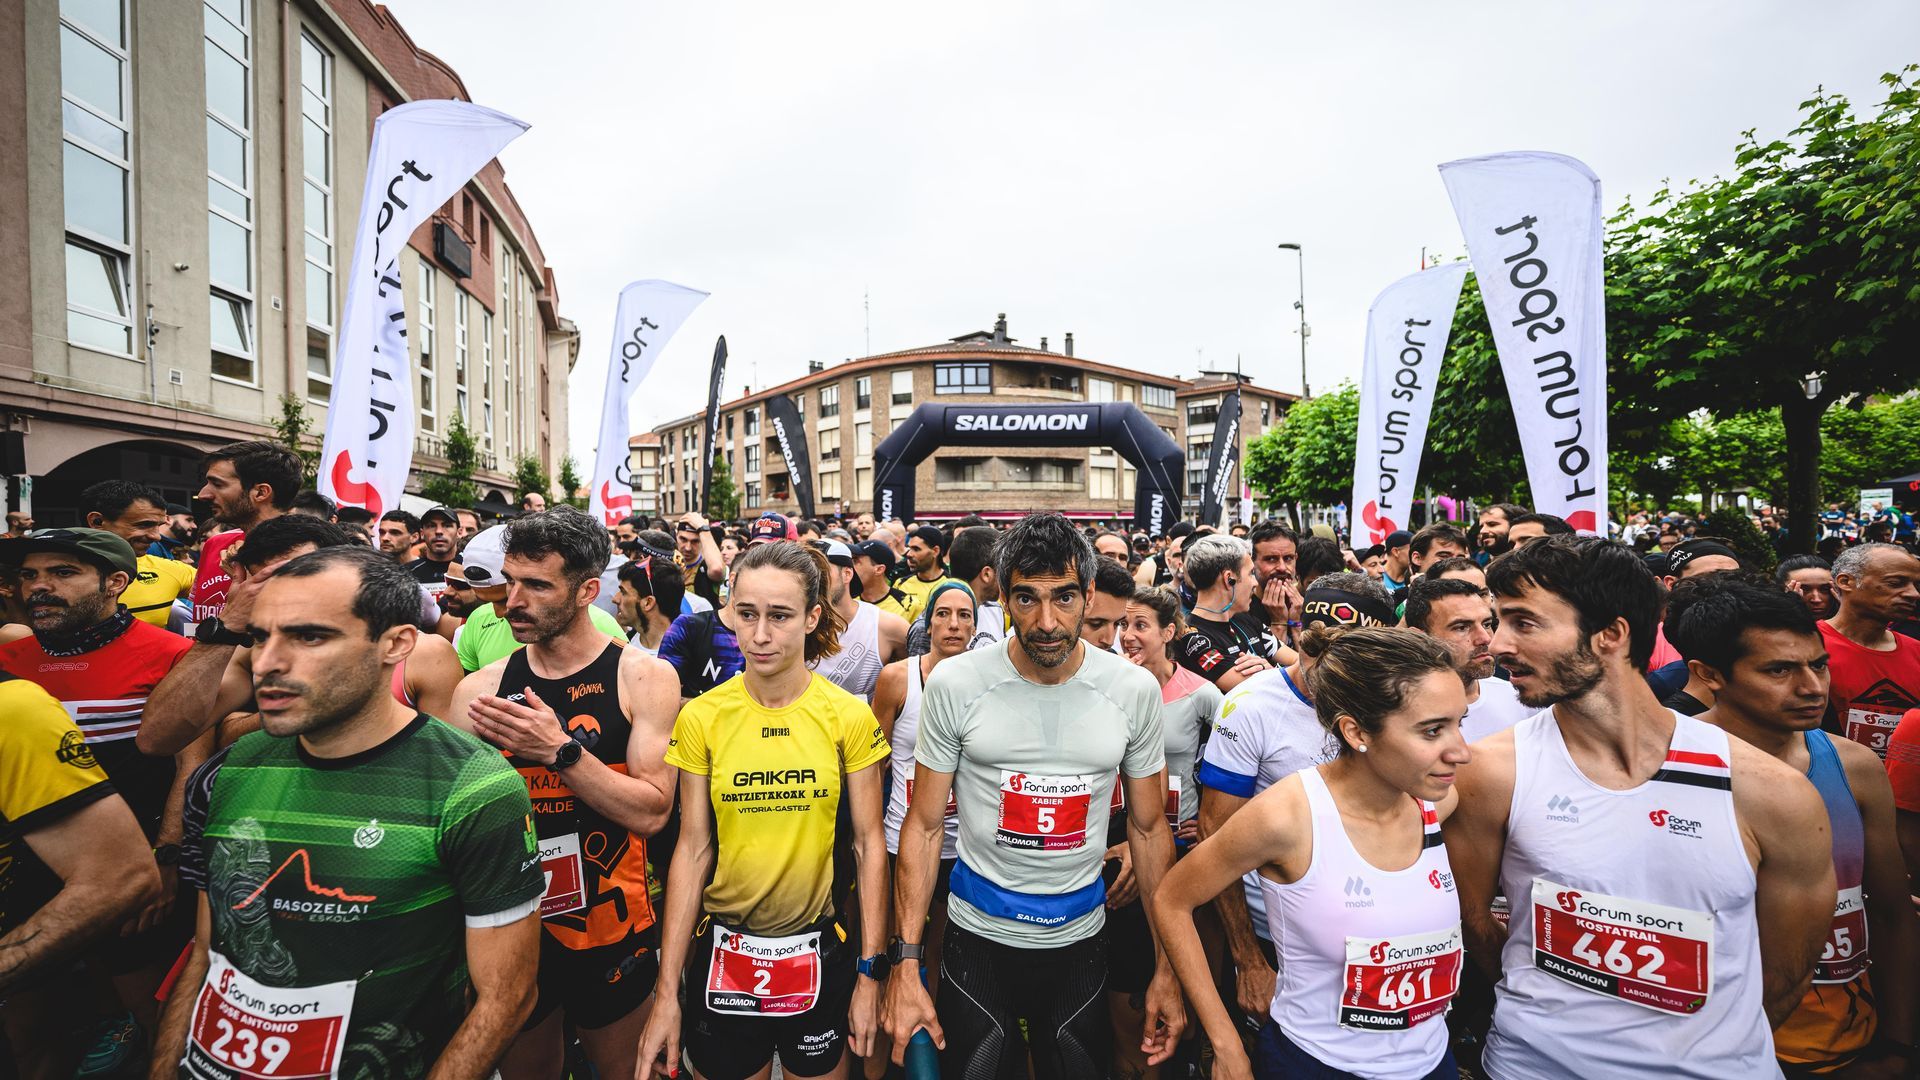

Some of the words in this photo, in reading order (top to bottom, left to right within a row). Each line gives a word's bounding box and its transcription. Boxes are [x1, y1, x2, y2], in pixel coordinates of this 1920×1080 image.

[1391, 318, 1432, 403] sport
[955, 413, 1089, 431] SALOMON
[1212, 419, 1238, 495] SALOMON
[201, 573, 232, 590] CURS
[733, 769, 817, 787] GAIKAR
[721, 789, 806, 802] ZORTZIETAKOAK
[1060, 783, 1087, 794] sport
[531, 800, 574, 814] KALDE
[1031, 797, 1063, 805] XABIER
[738, 804, 811, 814] VITORIA-GASTEIZ
[1037, 807, 1056, 833] 5
[1669, 823, 1697, 833] sport
[996, 833, 1039, 846] SALOMON
[273, 899, 369, 915] BASOZELAI
[308, 914, 361, 923] ESKOLA
[1016, 913, 1067, 925] SALOMON
[1636, 914, 1684, 932] sport
[1575, 918, 1661, 943] KOSTATRAIL
[774, 943, 802, 957] sport
[1425, 940, 1452, 955] sport
[752, 959, 774, 968] SARA
[1572, 932, 1667, 984] 462
[1384, 958, 1436, 975] KOSTATRAIL
[1544, 959, 1608, 987] SALOMON
[753, 969, 771, 995] 2
[1378, 968, 1433, 1009] 461
[713, 997, 756, 1007] SALOMON
[1623, 987, 1660, 1002] LABORAL
[268, 1001, 320, 1017] sport
[218, 1002, 240, 1020] JOSE
[240, 1012, 299, 1033] ANTONIO
[1349, 1014, 1403, 1025] SALOMON
[1411, 1012, 1431, 1022] LABORAL
[803, 1029, 835, 1043] GAIKAR
[210, 1018, 291, 1075] 239
